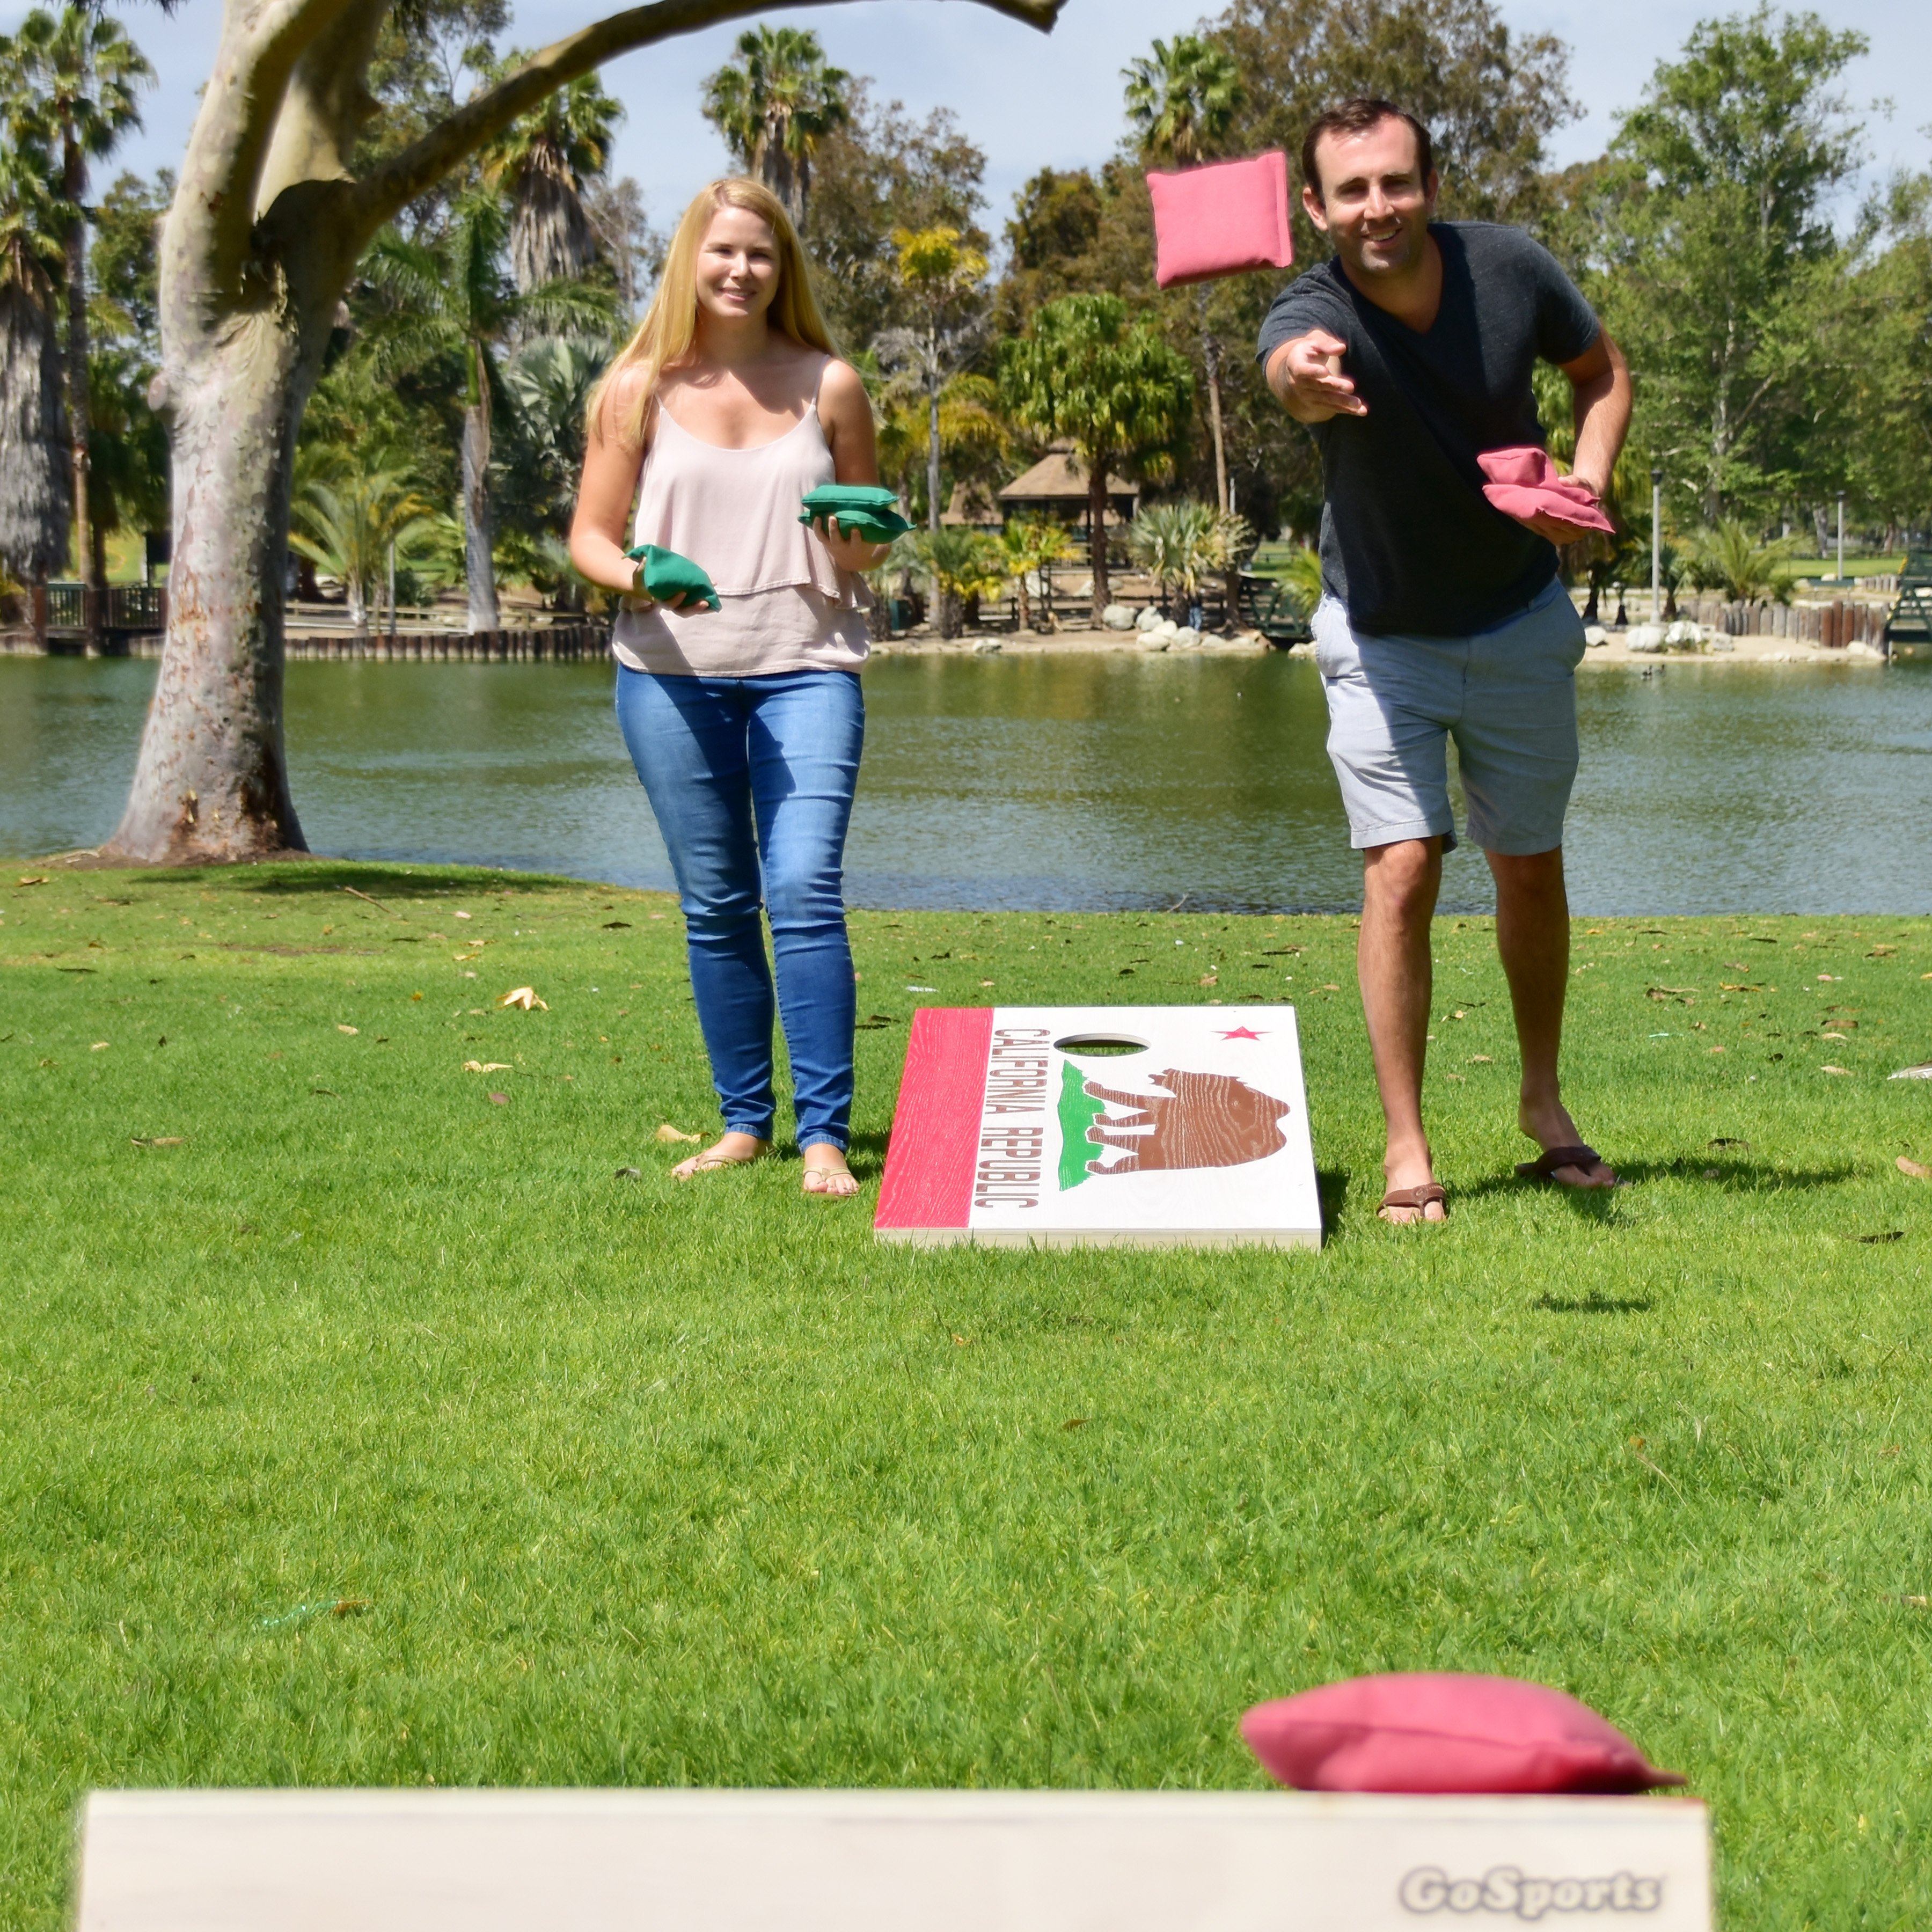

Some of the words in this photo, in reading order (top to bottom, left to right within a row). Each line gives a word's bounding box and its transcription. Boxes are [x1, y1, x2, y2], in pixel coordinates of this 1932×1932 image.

[985, 1029, 1050, 1115] CALIFORNIA
[974, 1128, 1043, 1208] REPUBLIC
[1400, 1865, 1662, 1921] GoSports
